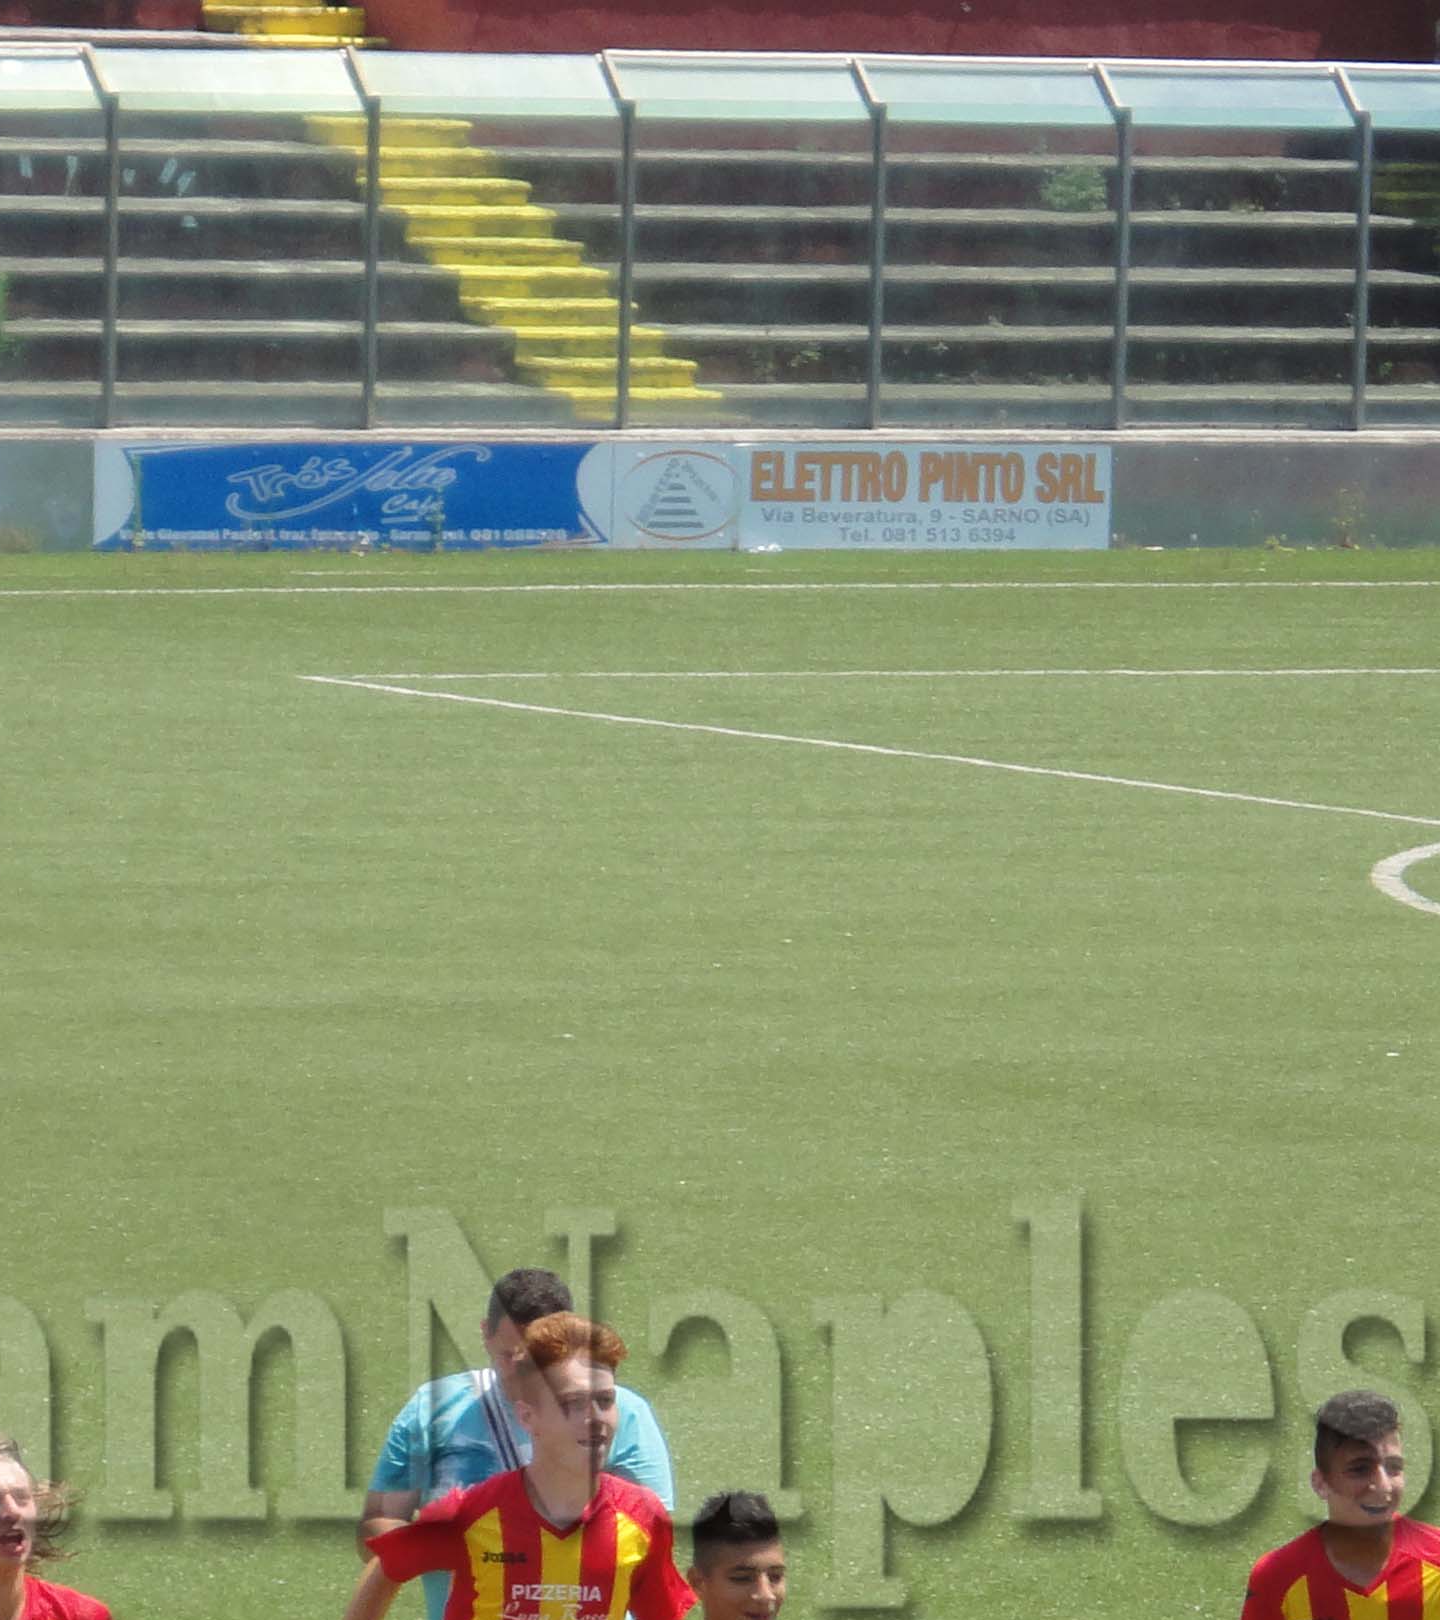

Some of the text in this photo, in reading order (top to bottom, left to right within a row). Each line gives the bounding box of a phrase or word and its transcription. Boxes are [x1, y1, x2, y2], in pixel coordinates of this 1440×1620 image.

[751, 450, 908, 502] ELETTRO
[918, 451, 1025, 502] PINTO
[1036, 453, 1104, 503] SRL
[761, 508, 796, 523] Via
[801, 508, 924, 526] Beveratura,
[929, 508, 942, 523] 9
[962, 508, 1040, 525] SARNO
[1046, 508, 1091, 528] (SA)
[841, 528, 1017, 543] Tel. 081 513 6394
[512, 1584, 602, 1602] PIZZERIA
